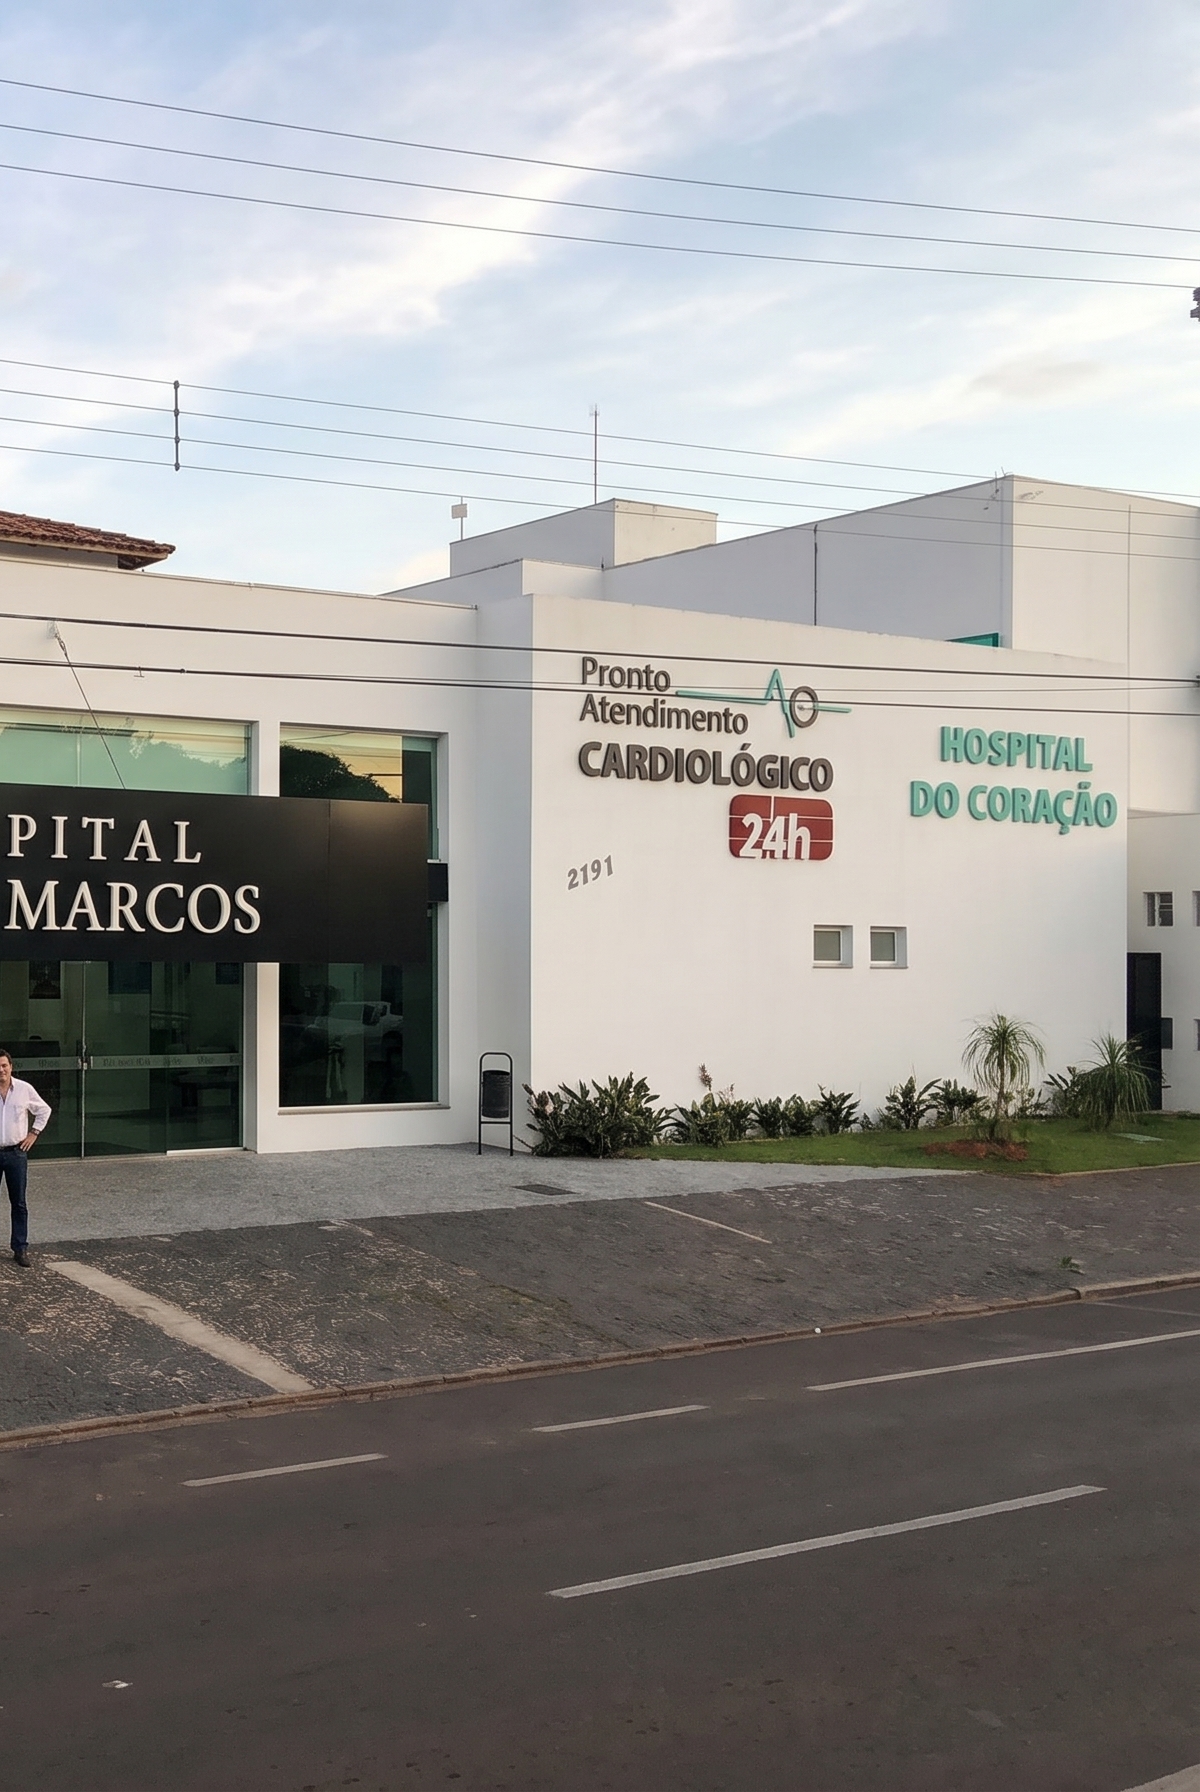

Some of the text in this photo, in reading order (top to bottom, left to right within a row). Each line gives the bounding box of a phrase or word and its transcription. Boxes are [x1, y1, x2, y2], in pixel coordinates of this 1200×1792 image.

[580, 656, 671, 692] Pronto
[579, 694, 749, 735] Atendimento
[578, 741, 834, 792] CARDIOLÓGICO
[940, 725, 1093, 772] HOSPITAL
[910, 780, 1118, 834] DO CORAÇÃO
[738, 812, 812, 860] 24h
[567, 855, 615, 891] 2191
[3, 879, 262, 934] MARCOS
